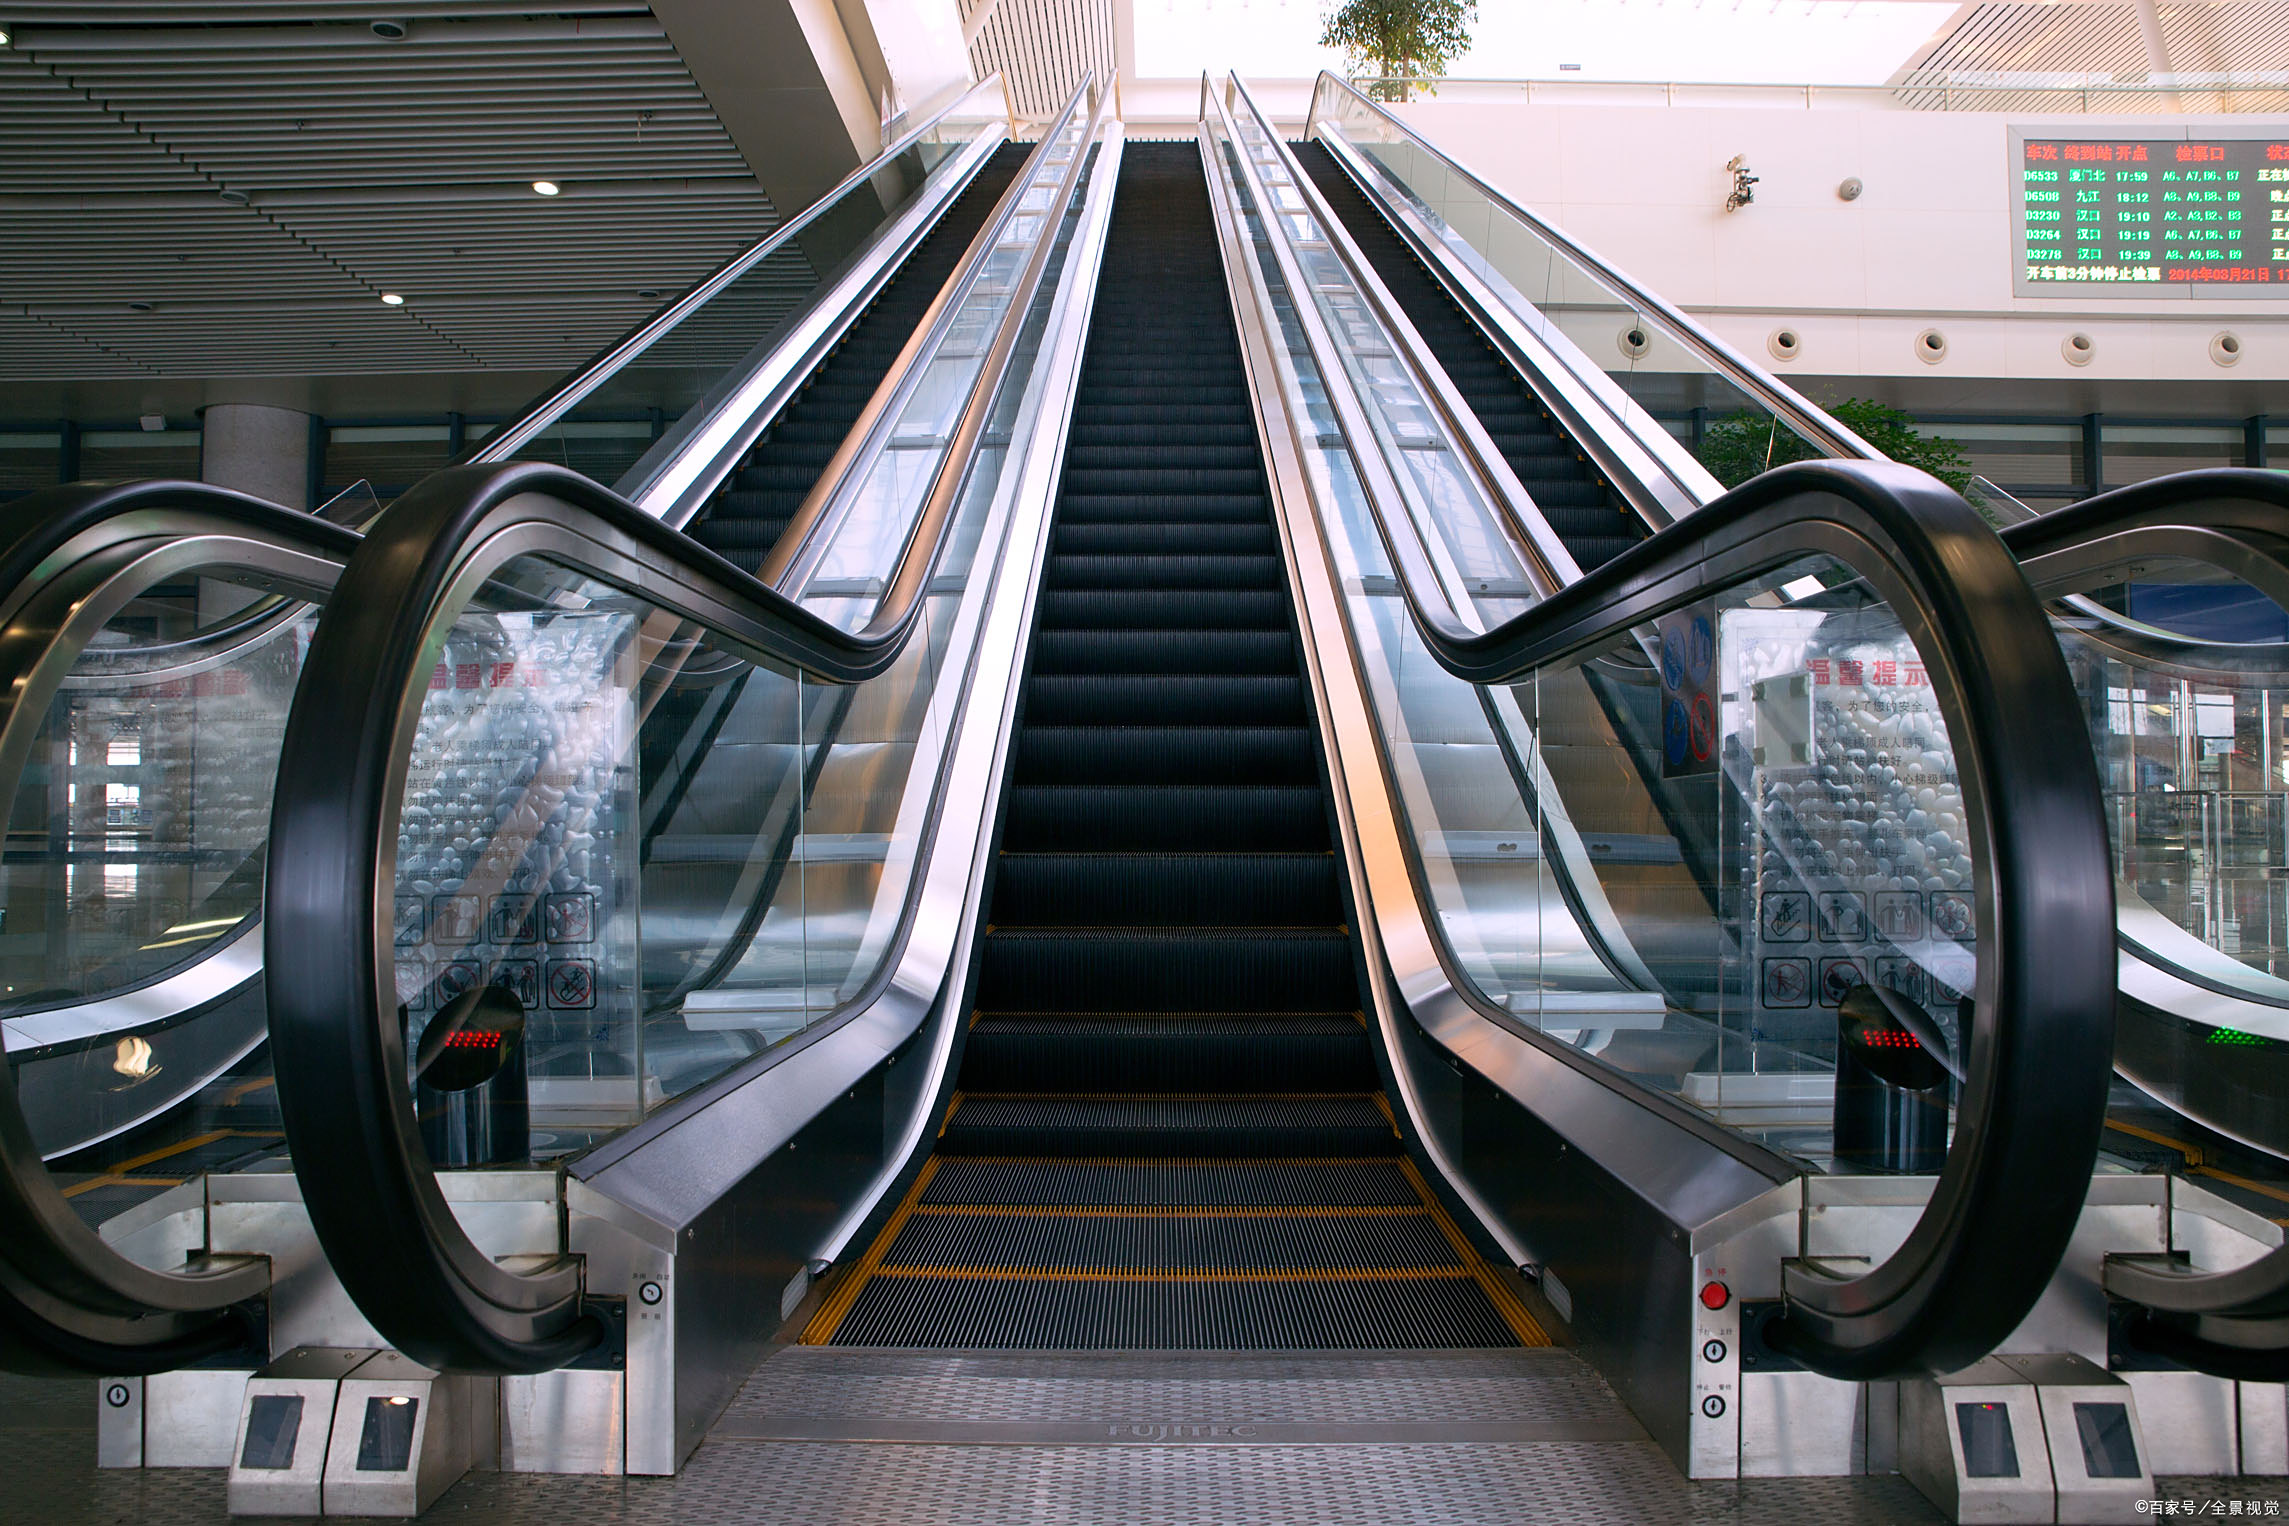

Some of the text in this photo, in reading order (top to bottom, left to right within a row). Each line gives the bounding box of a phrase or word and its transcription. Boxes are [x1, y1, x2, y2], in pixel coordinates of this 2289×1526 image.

[2027, 144, 2058, 161] 车次
[2064, 144, 2113, 162] 终到站
[2116, 144, 2148, 161] 开点
[2176, 145, 2224, 162] 检票口
[2024, 170, 2058, 182] D6533
[2069, 168, 2106, 182] 厦门北
[2116, 171, 2149, 182] 17:59
[2024, 190, 2060, 202] D6508
[2076, 189, 2100, 203] 九江
[2117, 192, 2149, 203] 18:12
[2025, 209, 2060, 222] D3230
[2076, 209, 2100, 222] 汉口
[2117, 211, 2150, 222] 19:10
[2026, 229, 2061, 241] D3264
[2077, 228, 2101, 241] 汉口
[2118, 230, 2151, 241] 19:19
[2026, 249, 2062, 260] D3278
[2077, 248, 2102, 260] 汉口
[2118, 250, 2152, 261] 19:39
[2026, 266, 2161, 281] 开车前3分钟停止检票
[2168, 266, 2270, 282] 2014年03月21日
[1806, 658, 1929, 687] 温馨提示
[1107, 1423, 1257, 1442] FUJITEC
